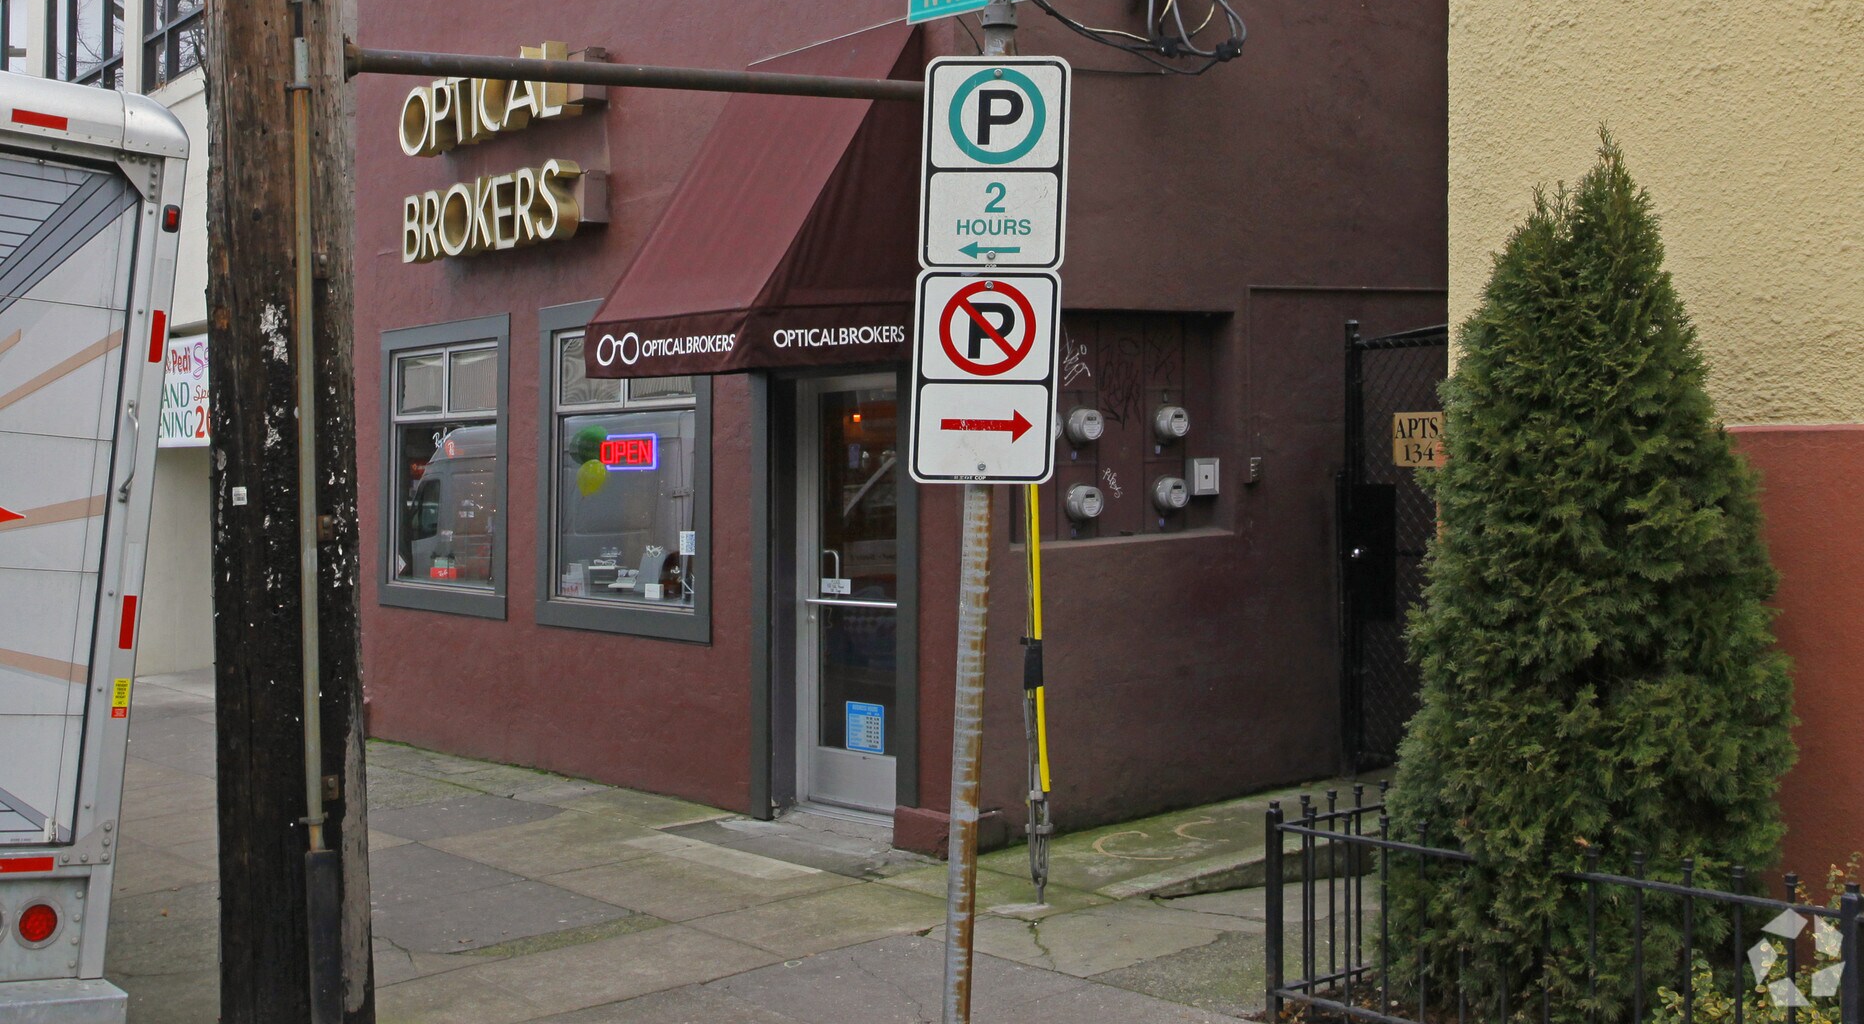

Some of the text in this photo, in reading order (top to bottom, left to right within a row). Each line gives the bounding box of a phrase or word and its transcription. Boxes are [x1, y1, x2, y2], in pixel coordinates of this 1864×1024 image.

[399, 41, 564, 156] OPTICAL
[976, 89, 1024, 146] P
[402, 158, 560, 263] BROKERS
[984, 181, 1006, 213] 2
[956, 218, 1032, 237] HOURS
[967, 302, 1015, 359] P
[171, 346, 192, 374] Pedi
[1395, 417, 1439, 439] APTS
[600, 440, 653, 465] OPEN
[1404, 441, 1435, 464] 134
